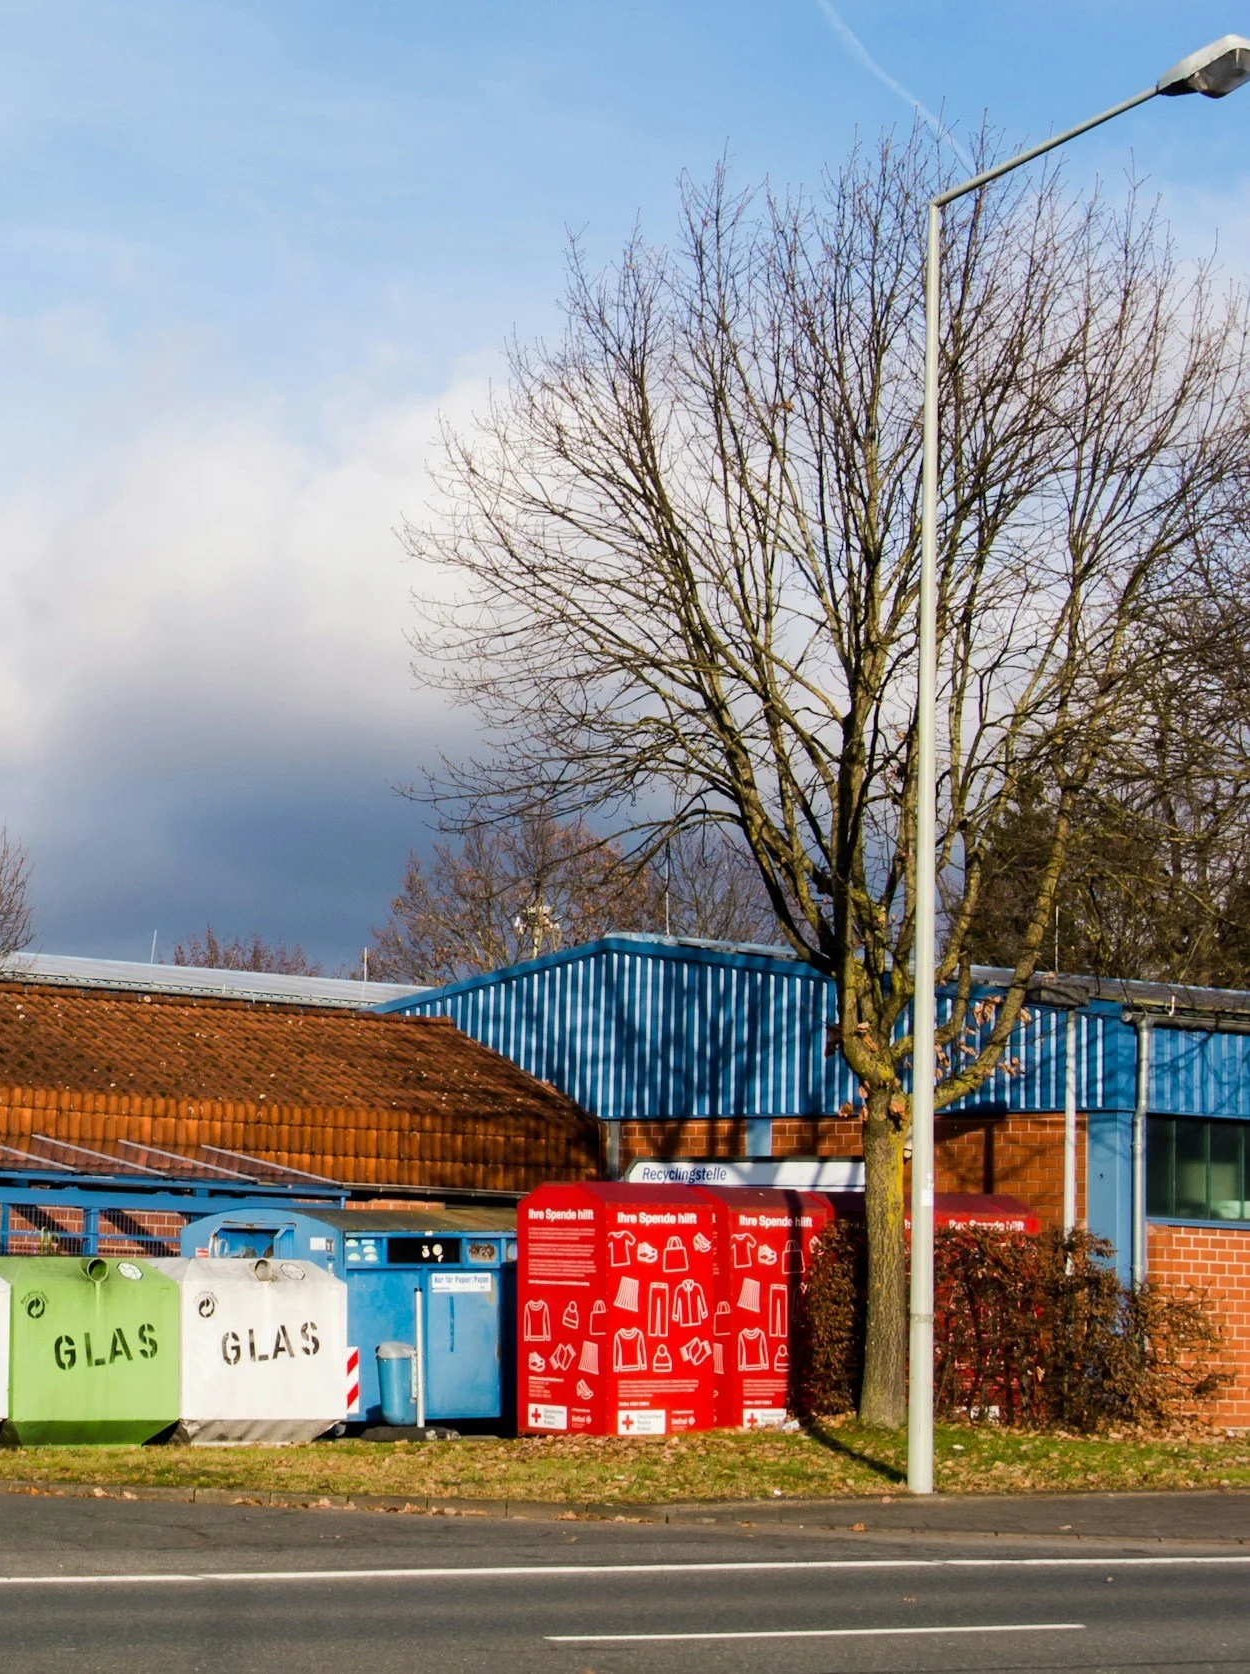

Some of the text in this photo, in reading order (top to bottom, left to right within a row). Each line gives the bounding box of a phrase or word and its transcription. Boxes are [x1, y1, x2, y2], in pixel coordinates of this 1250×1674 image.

[642, 1167, 727, 1184] Recyclingstelle
[528, 1208, 595, 1222] Ihre Spende hilft
[617, 1212, 637, 1224] Ihre
[638, 1212, 676, 1226] Spende
[677, 1212, 697, 1224] hilft
[739, 1214, 813, 1228] Ihre Spende hilft
[54, 1323, 158, 1371] GLAS
[221, 1321, 320, 1366] GLAS
